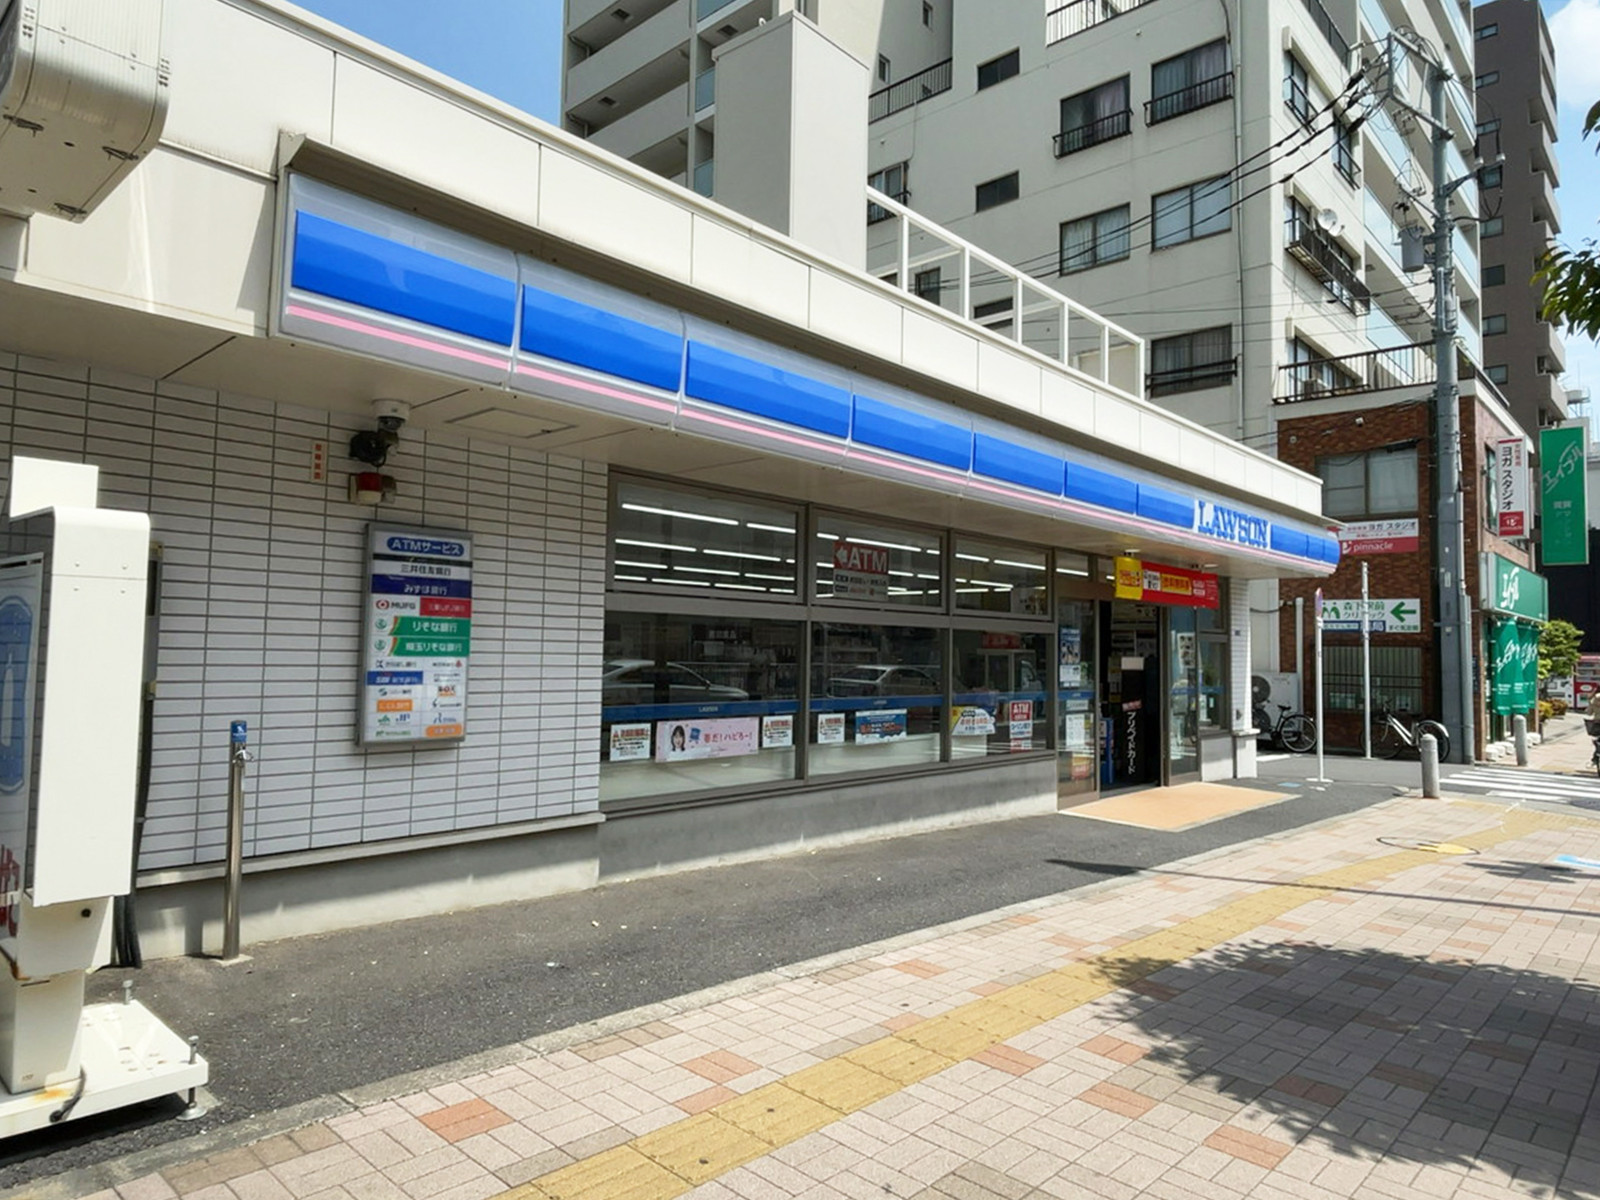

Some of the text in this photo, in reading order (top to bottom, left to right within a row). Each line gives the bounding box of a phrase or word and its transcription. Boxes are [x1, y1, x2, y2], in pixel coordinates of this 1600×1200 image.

[1542, 441, 1583, 494] エイブル
[1502, 446, 1513, 511] ヨガ スタジオ
[1198, 500, 1268, 548] LAWSON
[1386, 521, 1416, 530] スタジオ
[391, 539, 461, 555] ATMサービス
[1353, 541, 1393, 552] pinnacle
[848, 547, 887, 572] ATM
[401, 564, 452, 576] 三井住友銀行
[404, 584, 448, 596] みずほ銀行
[390, 601, 416, 610] MUFG
[412, 621, 458, 633] りそな銀行
[405, 641, 463, 652] 埼玉りそな銀行
